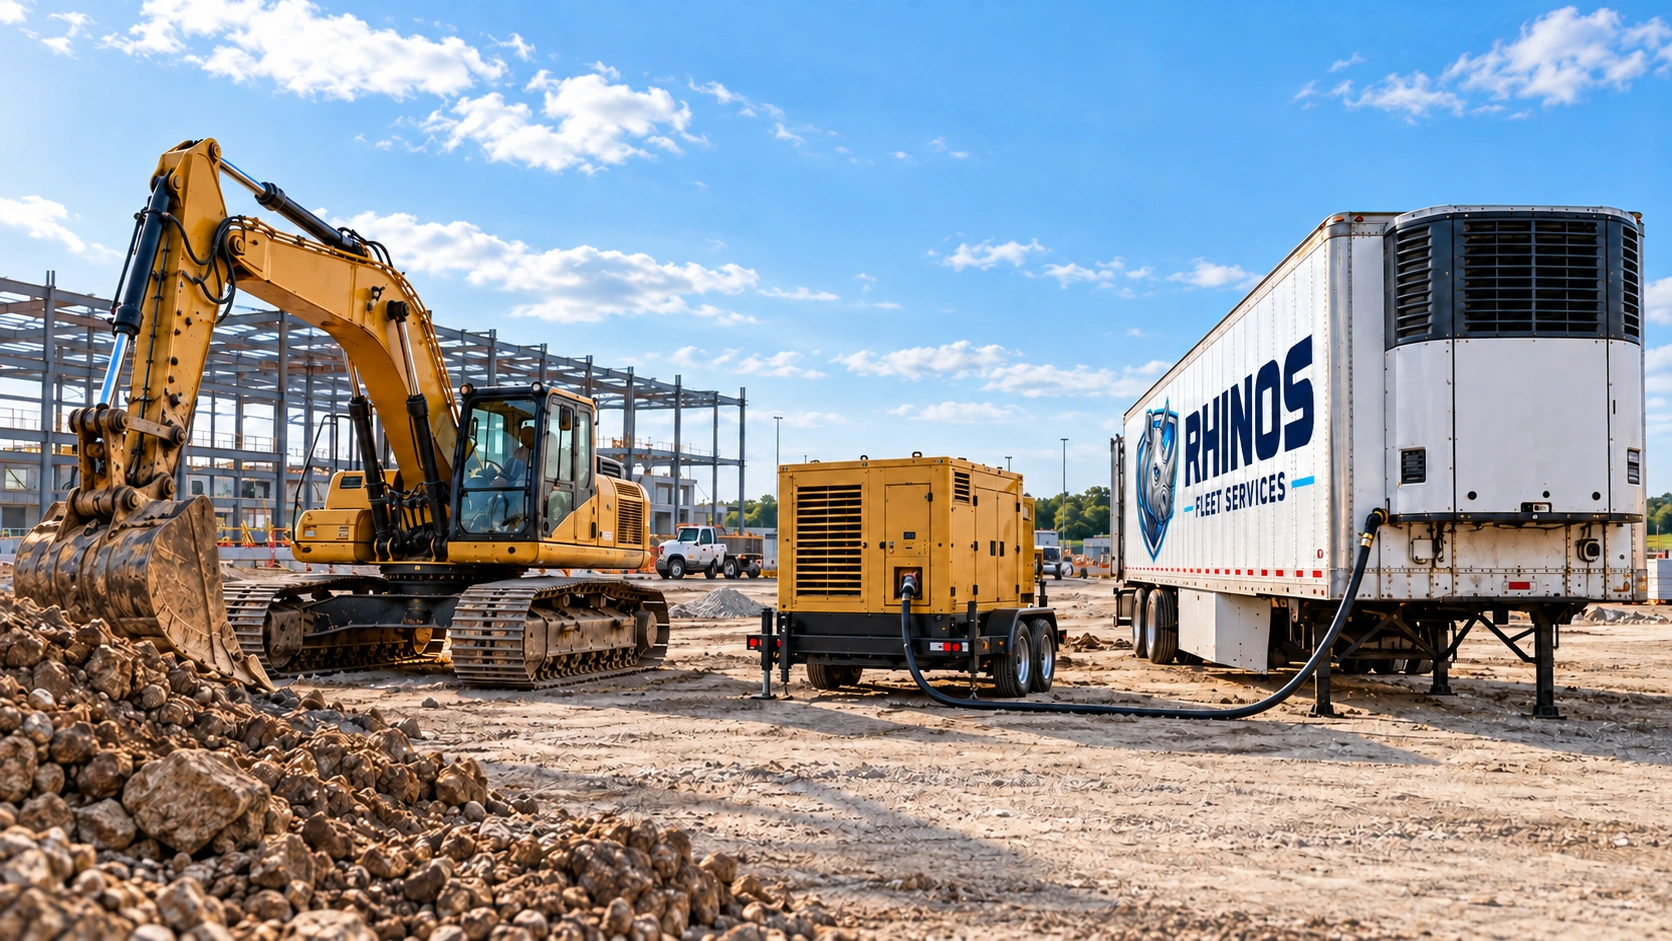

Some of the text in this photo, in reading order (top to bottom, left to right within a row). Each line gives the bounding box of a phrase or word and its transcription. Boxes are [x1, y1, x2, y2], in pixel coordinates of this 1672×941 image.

[1184, 334, 1315, 488] RHINOS
[1195, 471, 1286, 518] FLEET SERVICES
